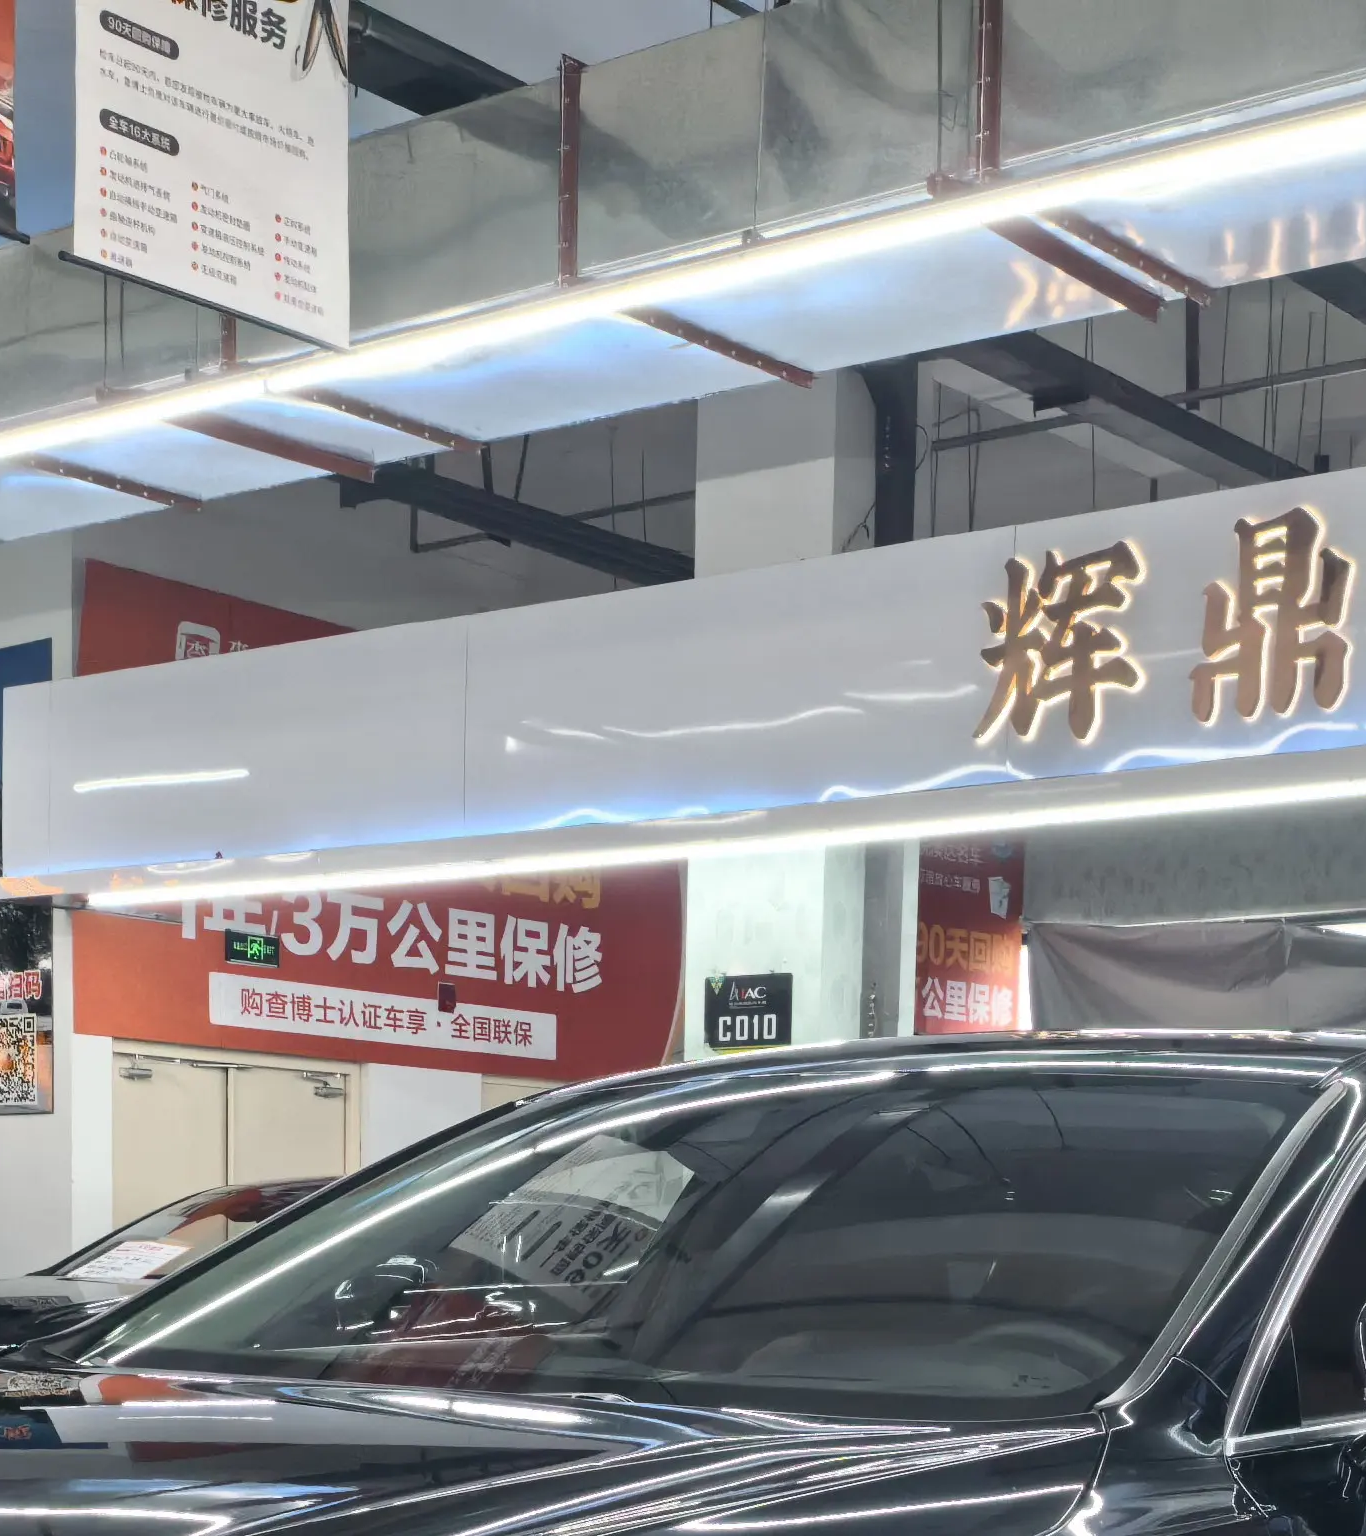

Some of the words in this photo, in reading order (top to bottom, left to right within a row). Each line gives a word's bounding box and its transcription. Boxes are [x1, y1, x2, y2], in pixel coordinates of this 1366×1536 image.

[917, 921, 1013, 973] 90天回购
[921, 976, 1013, 1025] 公里保修
